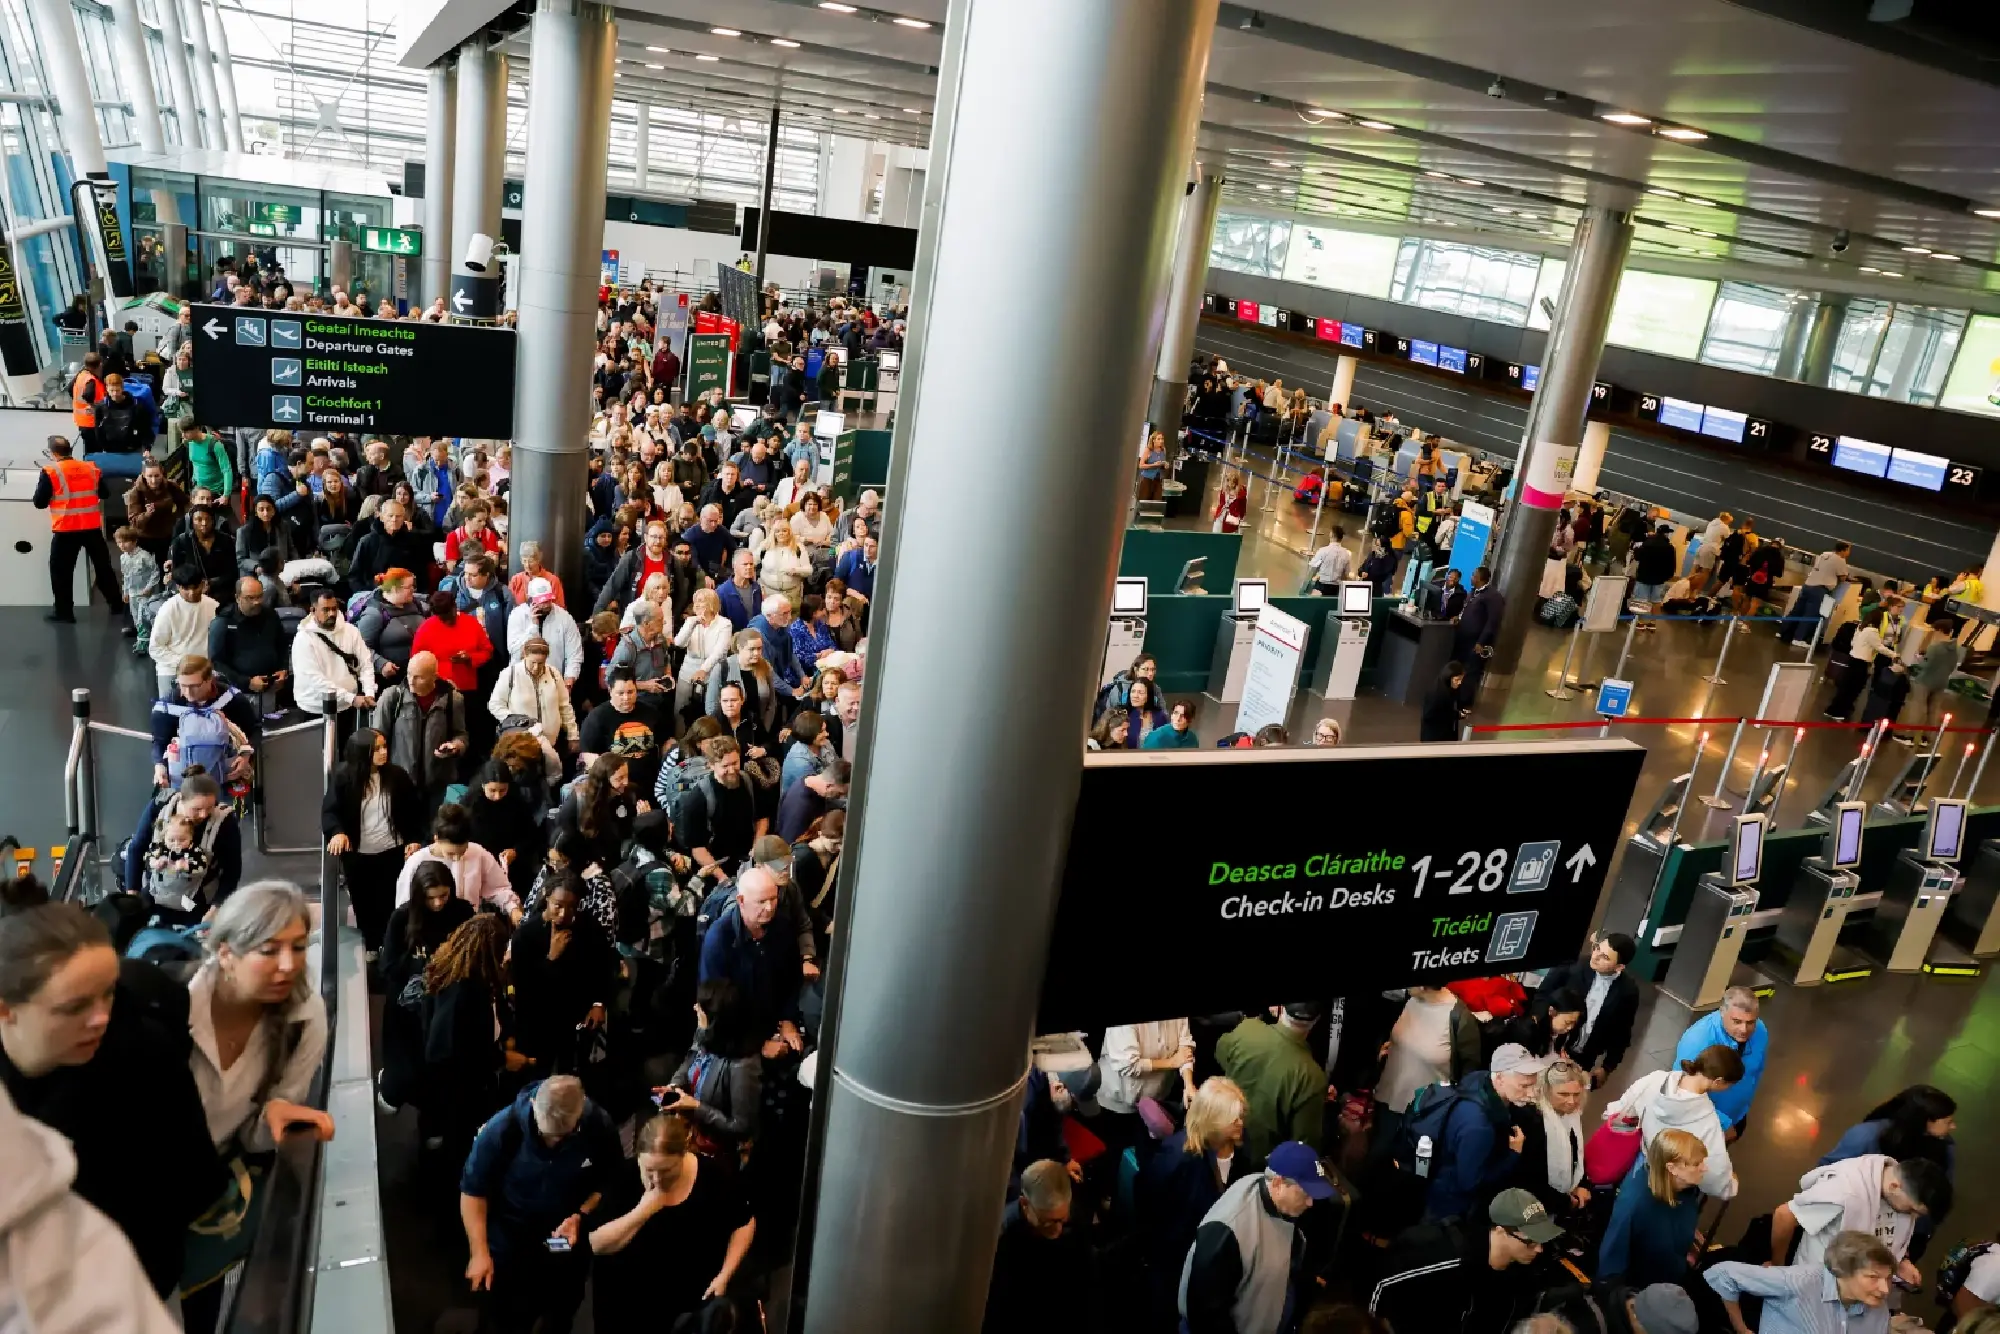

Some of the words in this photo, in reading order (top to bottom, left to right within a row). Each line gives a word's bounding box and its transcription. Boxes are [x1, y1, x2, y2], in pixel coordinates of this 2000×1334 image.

[1228, 301, 1236, 311] 12
[1278, 311, 1287, 323] 13
[305, 320, 352, 336] Geataí
[355, 323, 415, 340] Imeachta
[1364, 332, 1374, 344] 15
[305, 337, 374, 354] Departure
[376, 343, 414, 357] Gates
[1397, 340, 1407, 352] 16
[305, 358, 340, 371] Eitiltí
[343, 361, 388, 375] Isteach
[1469, 356, 1480, 369] 17
[1508, 365, 1519, 379] 18
[305, 374, 357, 389] Arrivals
[1594, 386, 1606, 399] 19
[306, 395, 372, 410] Críochfort
[375, 399, 382, 410] 1
[1641, 396, 1657, 411] 20
[306, 411, 364, 426] Terminal
[368, 415, 374, 426] 1
[1750, 421, 1766, 437] 21
[1811, 435, 1829, 452] 22
[1950, 468, 1974, 486] 23
[1208, 861, 1297, 886] Deasca
[1304, 849, 1406, 879] Cláraithe
[1220, 891, 1324, 920] Check-in
[1328, 883, 1396, 911] Desks
[1432, 911, 1492, 938] Ticéid
[1411, 946, 1480, 971] Tickets
